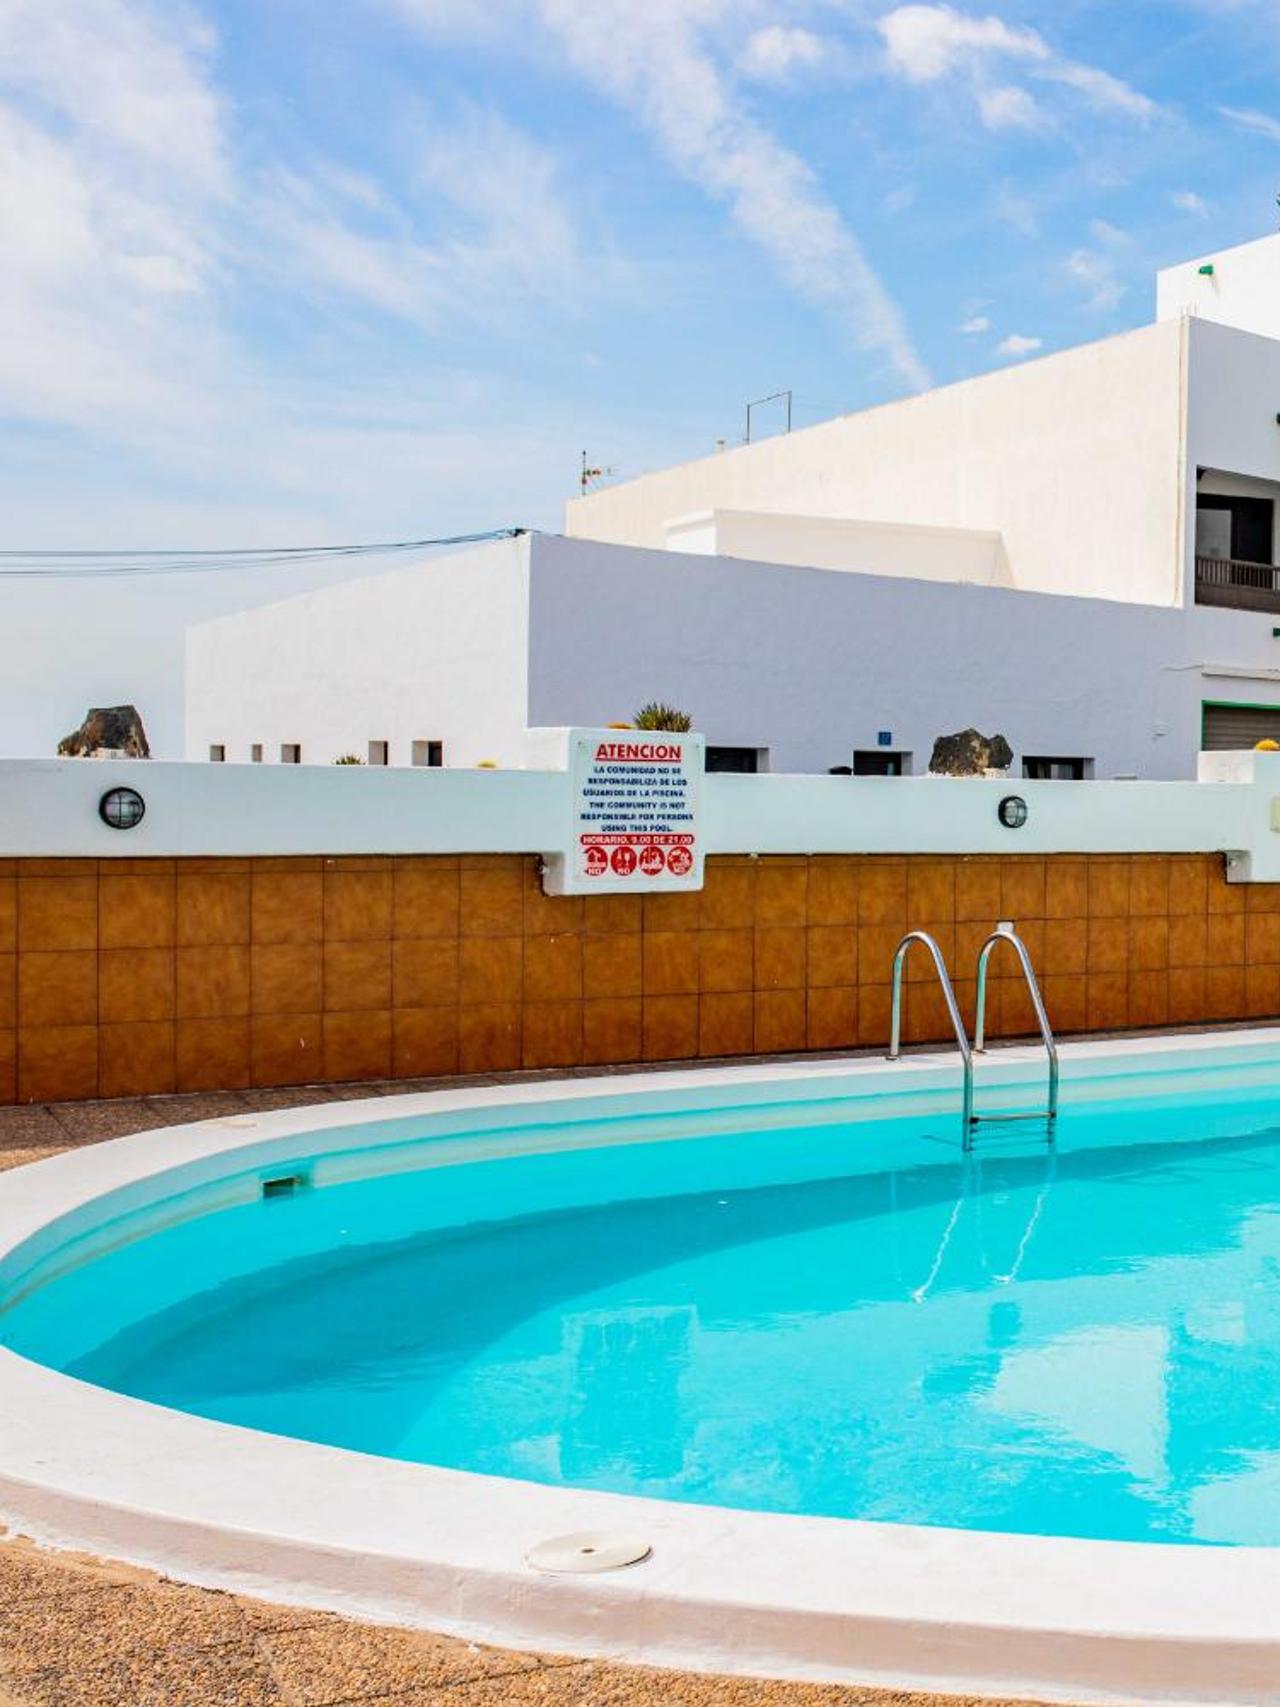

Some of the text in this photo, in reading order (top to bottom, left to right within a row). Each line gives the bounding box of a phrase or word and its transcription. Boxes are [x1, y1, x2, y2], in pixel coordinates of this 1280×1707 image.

[597, 743, 681, 759] ATENCION
[594, 766, 605, 774] LA
[607, 766, 656, 774] COMUNIDAD
[660, 778, 669, 786] DE
[583, 788, 625, 797] USUARIOS
[627, 789, 637, 797] DE
[640, 789, 649, 797] LA
[601, 824, 627, 832] USING
[629, 824, 648, 832] THIS
